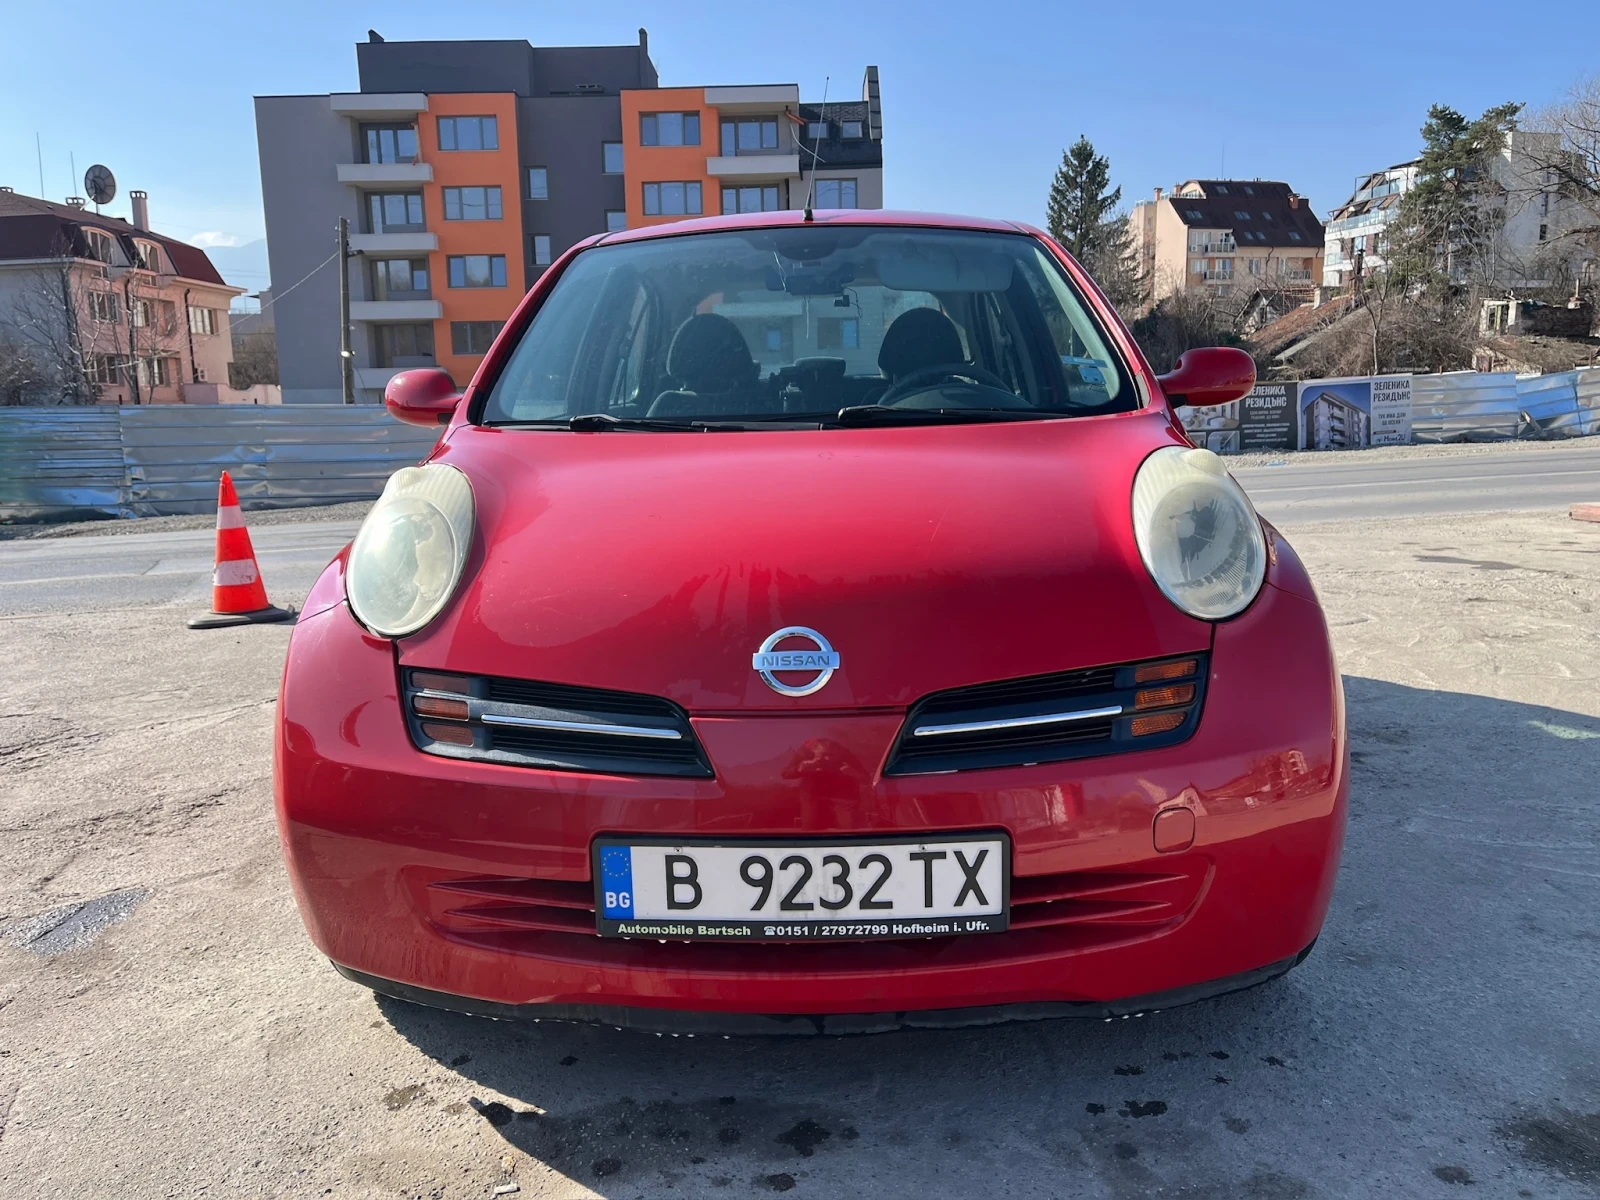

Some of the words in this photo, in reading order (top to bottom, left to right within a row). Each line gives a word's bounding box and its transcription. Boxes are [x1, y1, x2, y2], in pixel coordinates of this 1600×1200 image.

[1250, 386, 1286, 396] ЕЛЕНИКА
[1374, 380, 1410, 391] ЗЕЛЕНИКА
[1245, 396, 1288, 409] РЕЗИДЪНС
[1373, 391, 1411, 402] РЕЗИДЪНС
[762, 655, 830, 667] NISSAN
[664, 854, 703, 911] B
[738, 854, 894, 912] 9232
[909, 849, 989, 909] TX
[605, 891, 631, 908] BG
[617, 923, 694, 936] Automobile
[697, 925, 751, 936] Bartsch
[821, 924, 889, 936] 27972799
[892, 923, 950, 935] Hofheim
[953, 922, 962, 932] i.
[965, 921, 990, 931] Ufr.
